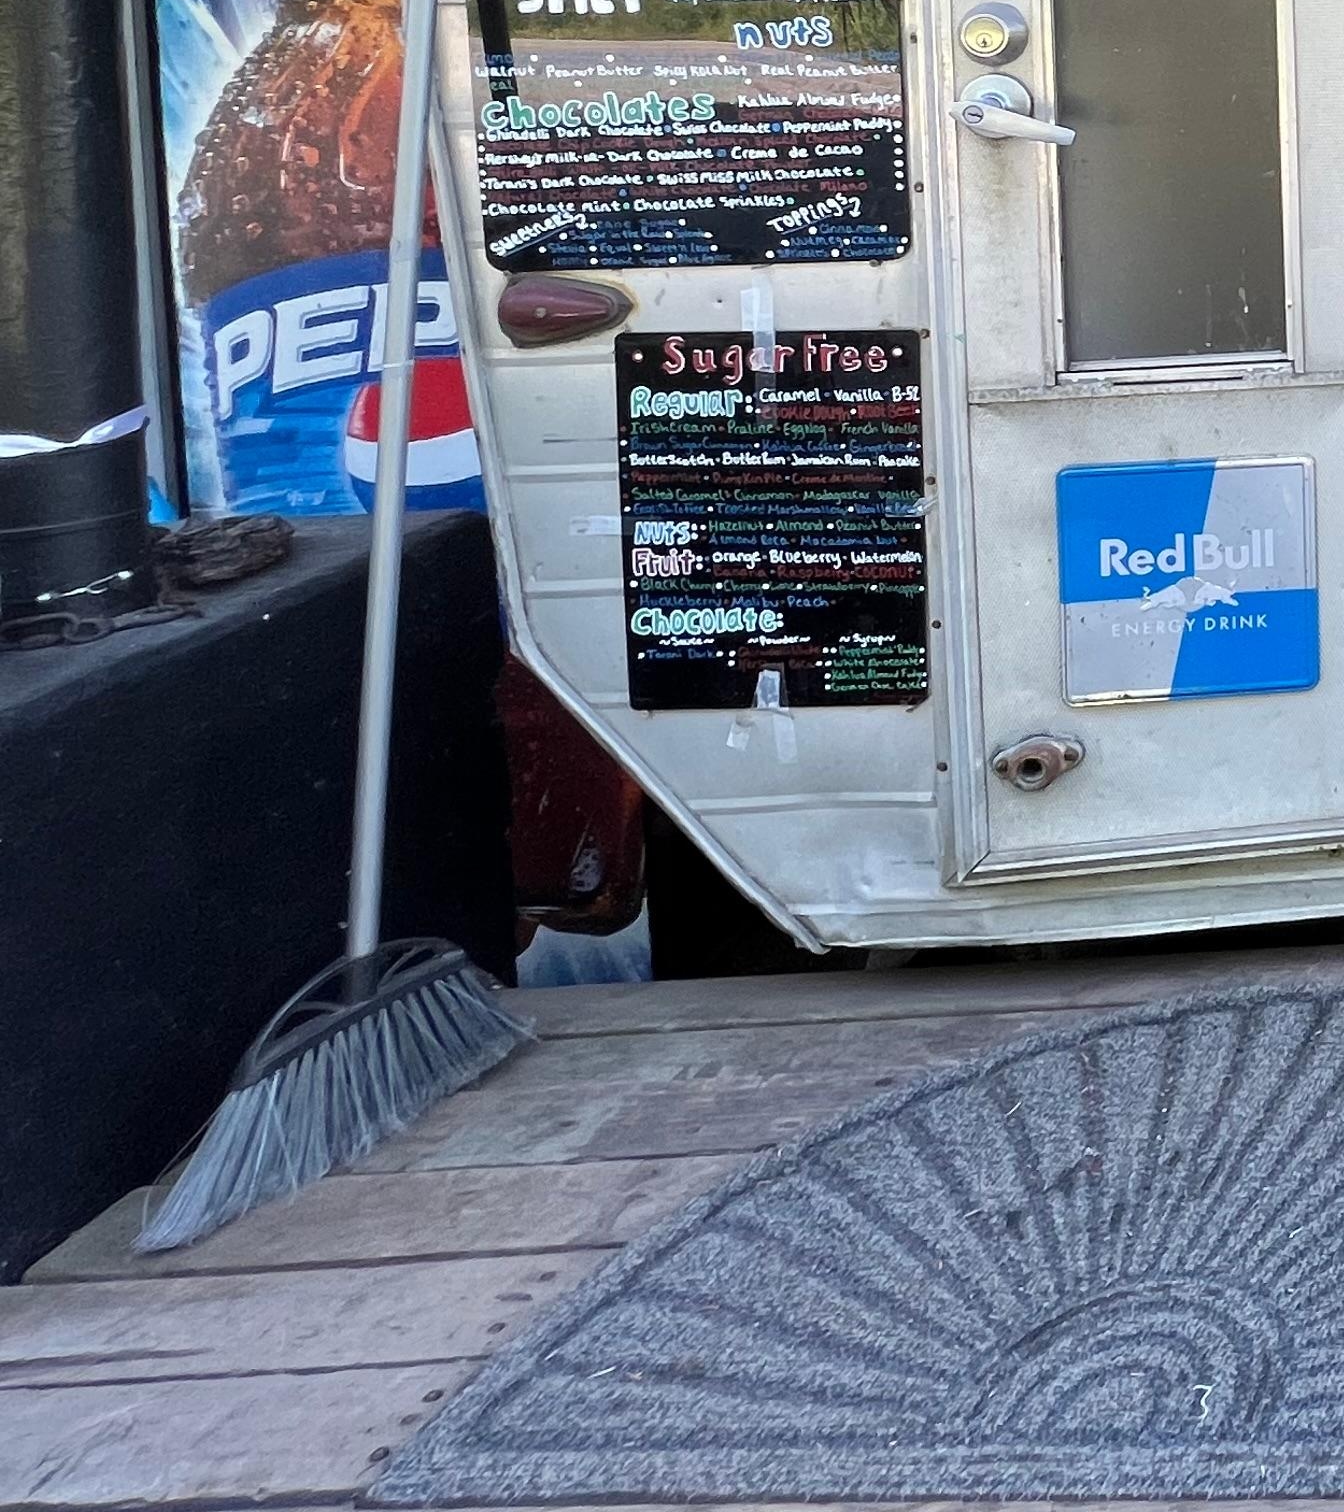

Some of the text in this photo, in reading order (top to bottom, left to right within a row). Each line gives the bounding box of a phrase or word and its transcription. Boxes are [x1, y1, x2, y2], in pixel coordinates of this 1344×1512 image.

[733, 15, 833, 50] nuts
[475, 64, 794, 78] Walnut Real
[481, 91, 715, 129] Chocolates
[789, 147, 808, 158] de
[815, 144, 863, 155] Cacao
[664, 333, 888, 385] Sugar Free
[759, 388, 820, 403] Caramel
[833, 388, 882, 402] Vanilla
[632, 548, 703, 577] Fruit:
[1100, 529, 1274, 577] Red Bull
[787, 595, 829, 608] Peach
[1111, 614, 1268, 637] ENERGY DRINK
